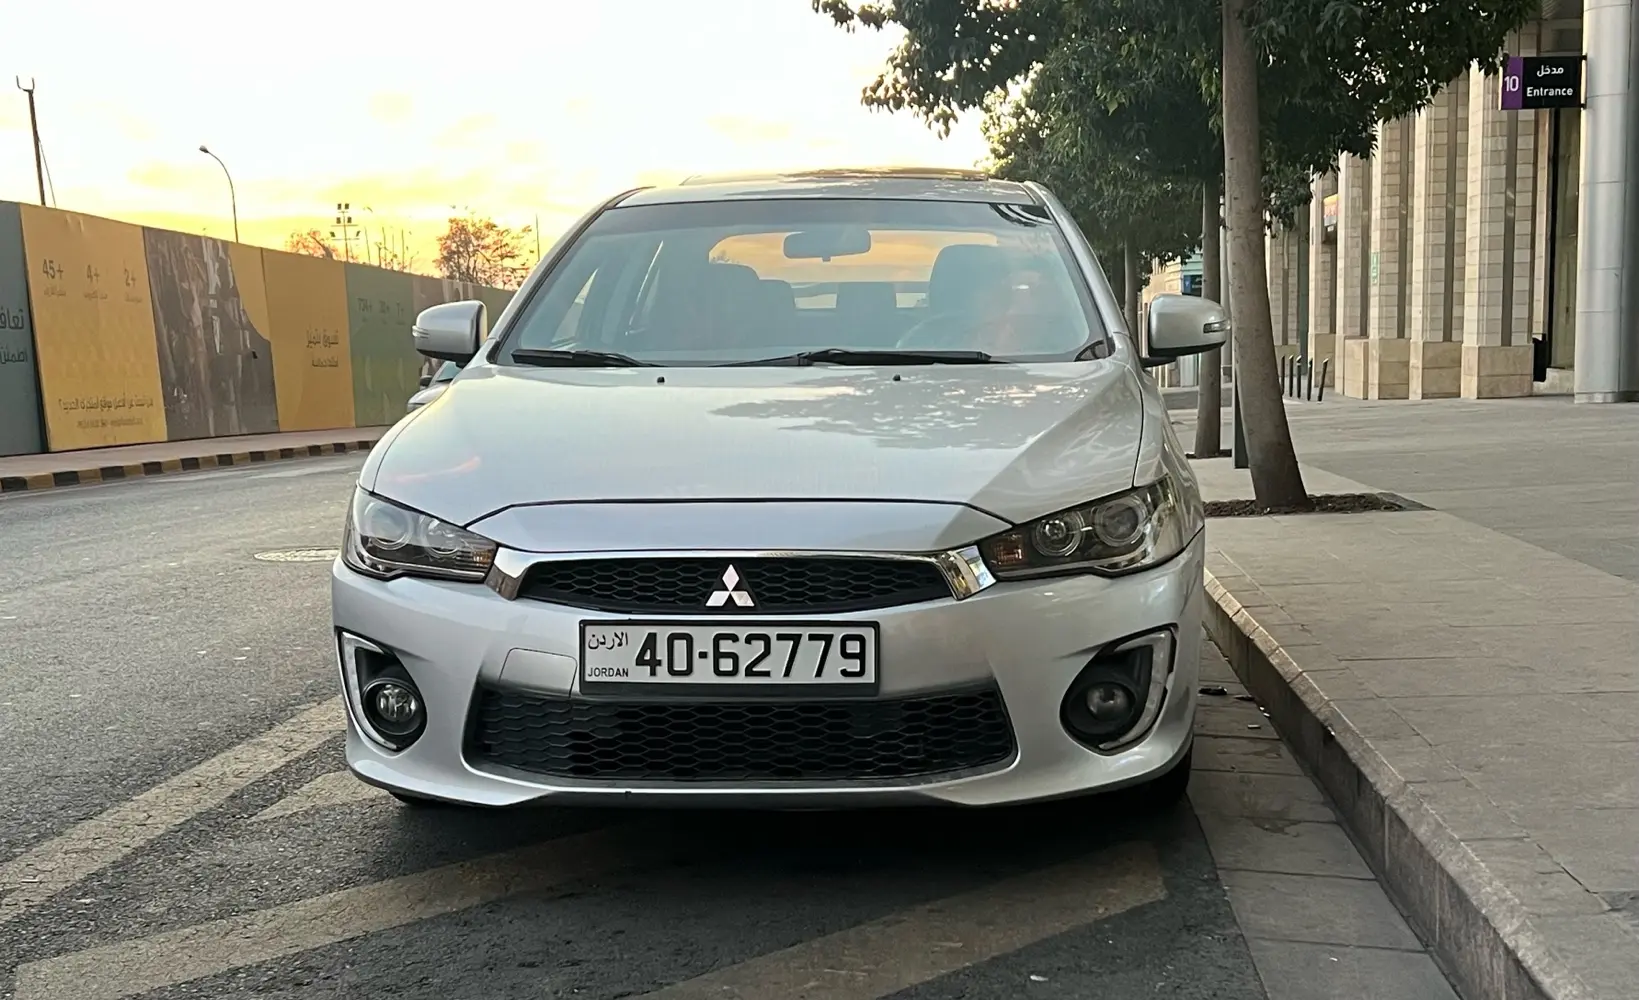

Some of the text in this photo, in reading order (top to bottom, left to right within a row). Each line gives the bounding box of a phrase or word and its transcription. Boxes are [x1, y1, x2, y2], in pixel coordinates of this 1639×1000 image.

[1537, 65, 1564, 77] مدخل
[1504, 76, 1519, 92] 10
[1527, 87, 1574, 97] Entrance
[42, 258, 64, 279] 45+
[635, 632, 866, 678] 40-62779
[588, 667, 629, 678] JORDAN
